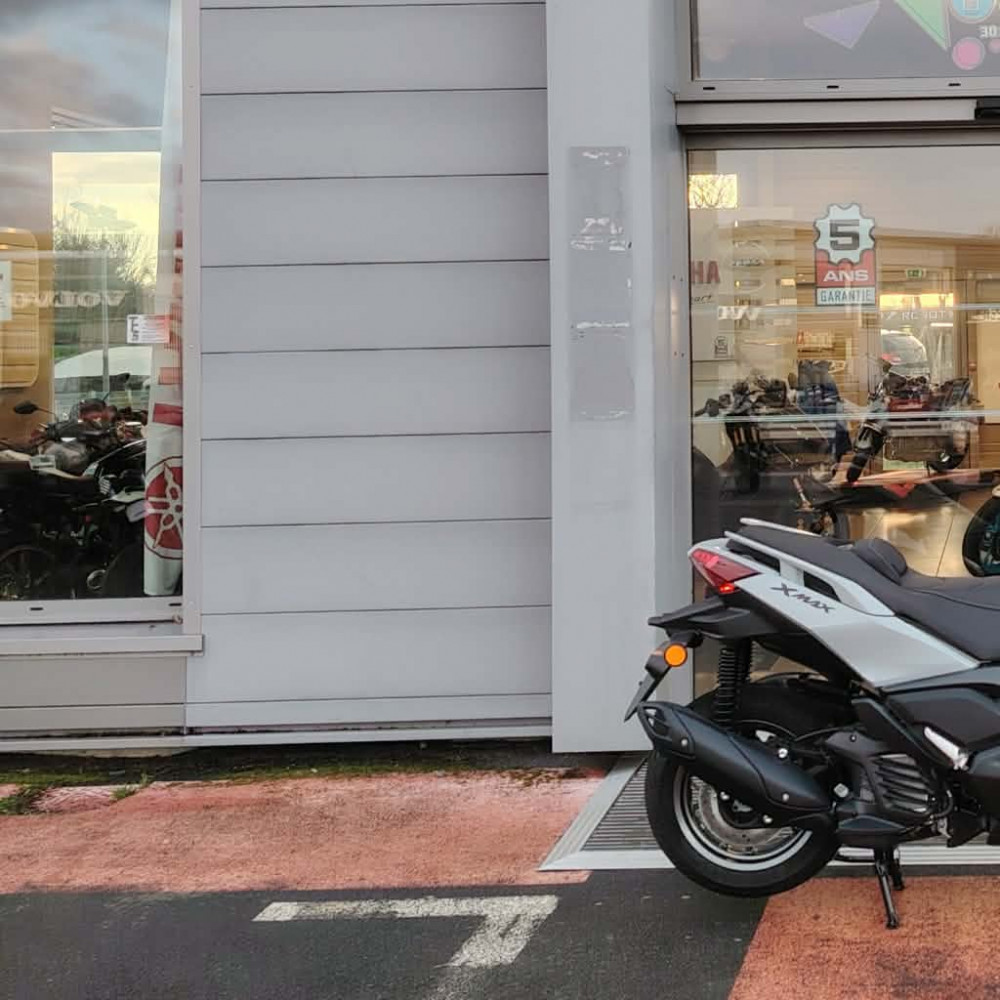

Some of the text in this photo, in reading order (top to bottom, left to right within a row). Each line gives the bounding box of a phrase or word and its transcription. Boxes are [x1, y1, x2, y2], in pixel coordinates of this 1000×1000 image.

[980, 25, 997, 38] 30
[829, 219, 860, 251] 5
[823, 269, 870, 282] ANS
[820, 287, 873, 303] GARANTIE
